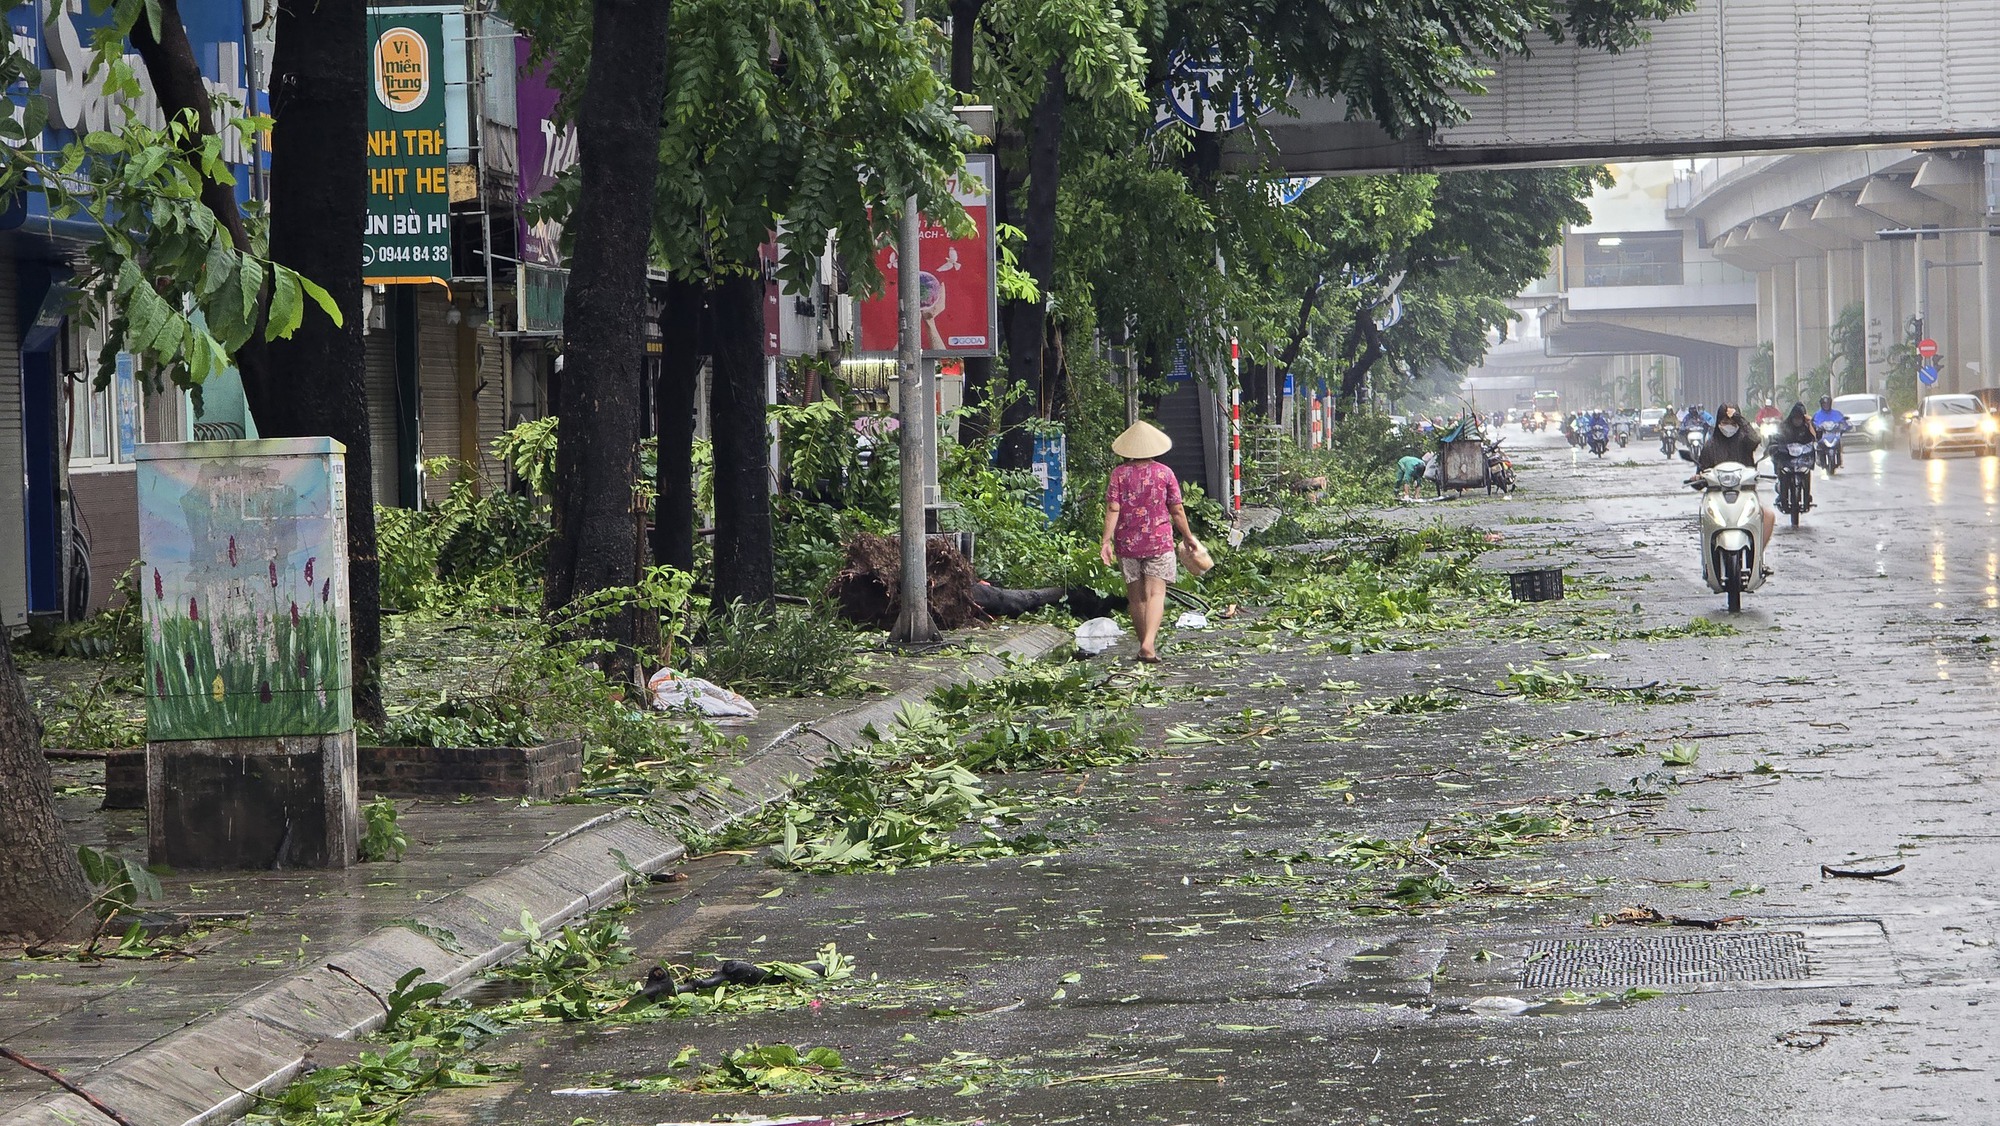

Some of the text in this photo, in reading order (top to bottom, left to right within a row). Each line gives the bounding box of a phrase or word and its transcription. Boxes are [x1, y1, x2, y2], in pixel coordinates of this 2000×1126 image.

[393, 41, 409, 57] Vị
[386, 59, 421, 73] miền
[383, 75, 422, 97] Trung
[367, 168, 408, 201] HỊT
[394, 208, 421, 235] BÒ
[379, 245, 448, 262] 0944 84 33
